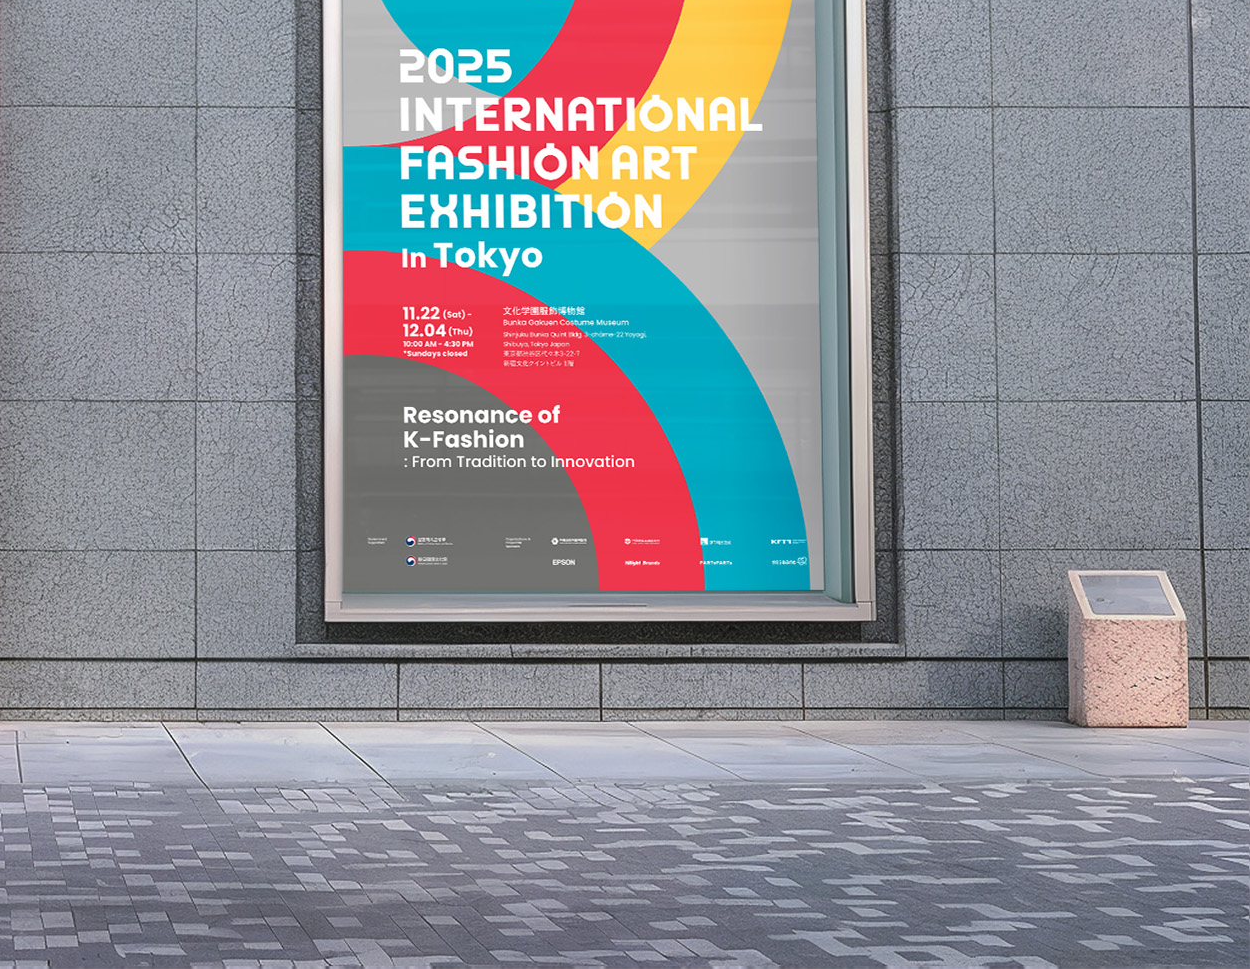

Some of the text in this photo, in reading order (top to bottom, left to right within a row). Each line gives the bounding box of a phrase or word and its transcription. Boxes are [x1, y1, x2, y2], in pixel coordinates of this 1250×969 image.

[399, 47, 513, 84] 2025
[400, 94, 764, 132] INTERNATIONAL
[400, 142, 698, 181] FASHION ART
[400, 191, 663, 229] EXHIBITION
[433, 240, 544, 277] Tokyo
[402, 306, 441, 321] 11.22
[442, 309, 466, 321] (Sat)
[402, 323, 473, 338] 12.04 (Thu)
[528, 319, 559, 327] Gakuen
[559, 319, 595, 327] Costume
[596, 319, 630, 327] Museum
[402, 340, 424, 348] 10:00
[424, 340, 438, 348] AM
[443, 340, 461, 348] 4:30
[461, 340, 474, 348] PM
[550, 341, 571, 349] Japan
[442, 350, 468, 358] closed
[403, 404, 561, 424] Resonance of
[403, 428, 525, 449] K-Fashion
[412, 455, 452, 468] From
[456, 454, 527, 468] Tradition
[530, 455, 547, 468] to
[551, 454, 635, 468] Innovation
